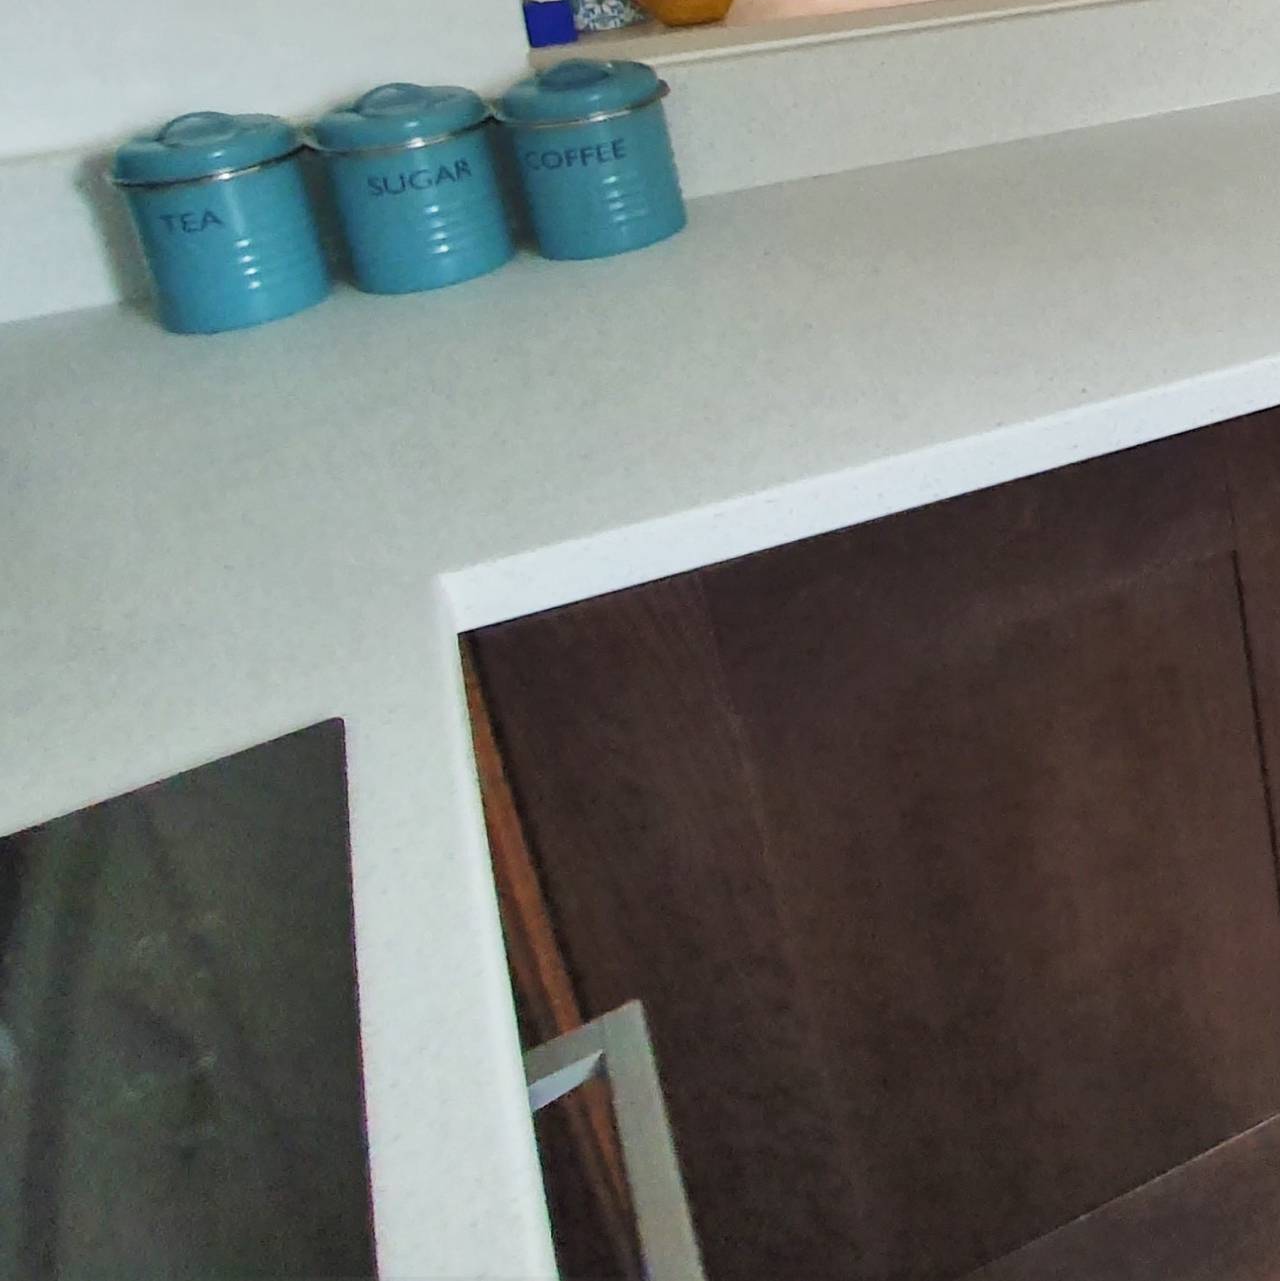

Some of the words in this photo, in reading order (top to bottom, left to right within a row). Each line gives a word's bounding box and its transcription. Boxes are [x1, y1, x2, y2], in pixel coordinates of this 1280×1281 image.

[524, 137, 627, 172] COFFEE
[366, 158, 472, 198] SUGAR
[159, 207, 223, 235] TEA
